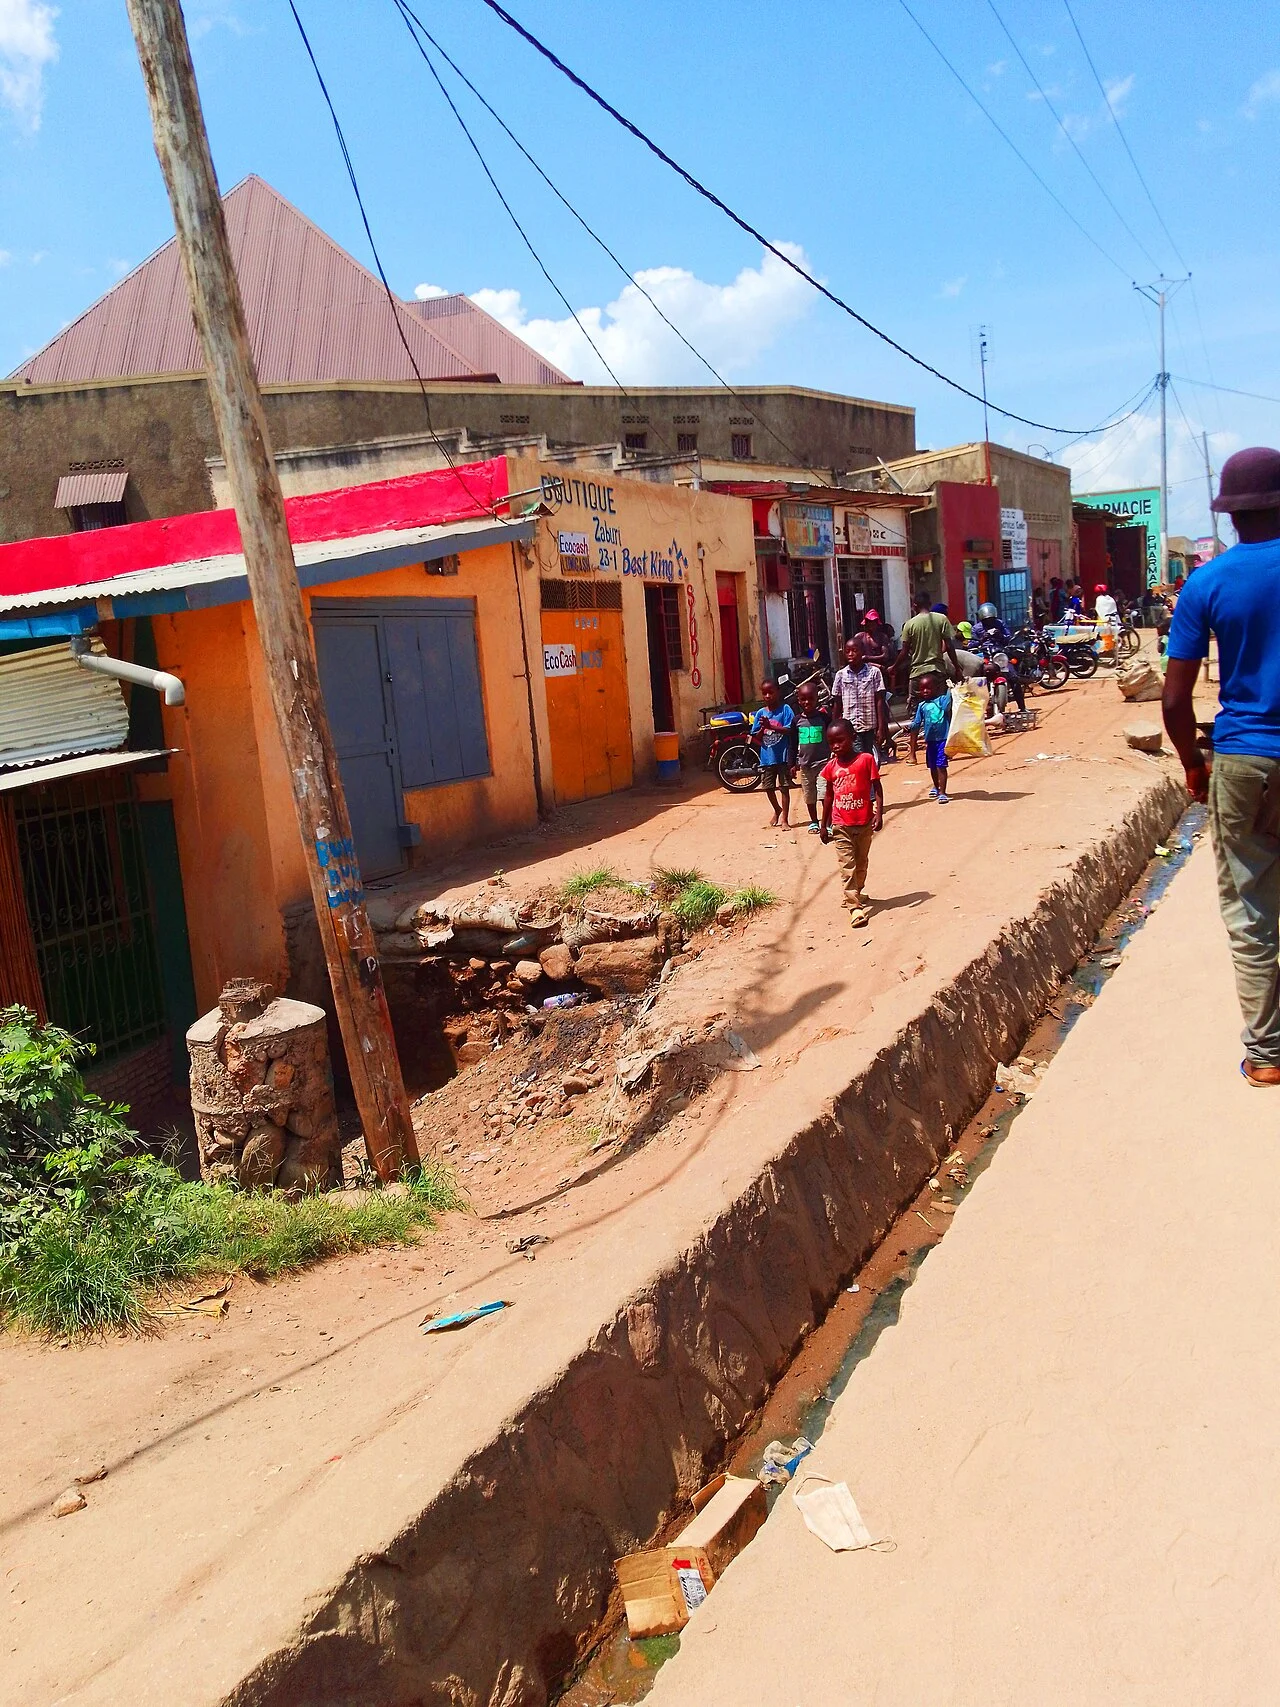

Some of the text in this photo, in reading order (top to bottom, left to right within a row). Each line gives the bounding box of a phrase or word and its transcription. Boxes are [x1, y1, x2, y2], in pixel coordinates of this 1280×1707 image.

[540, 475, 617, 514] BOUTIQUE
[1084, 499, 1152, 515] RMACIE
[622, 547, 674, 582] Best King
[544, 650, 577, 670] EcoCash
[799, 726, 823, 744] 25
